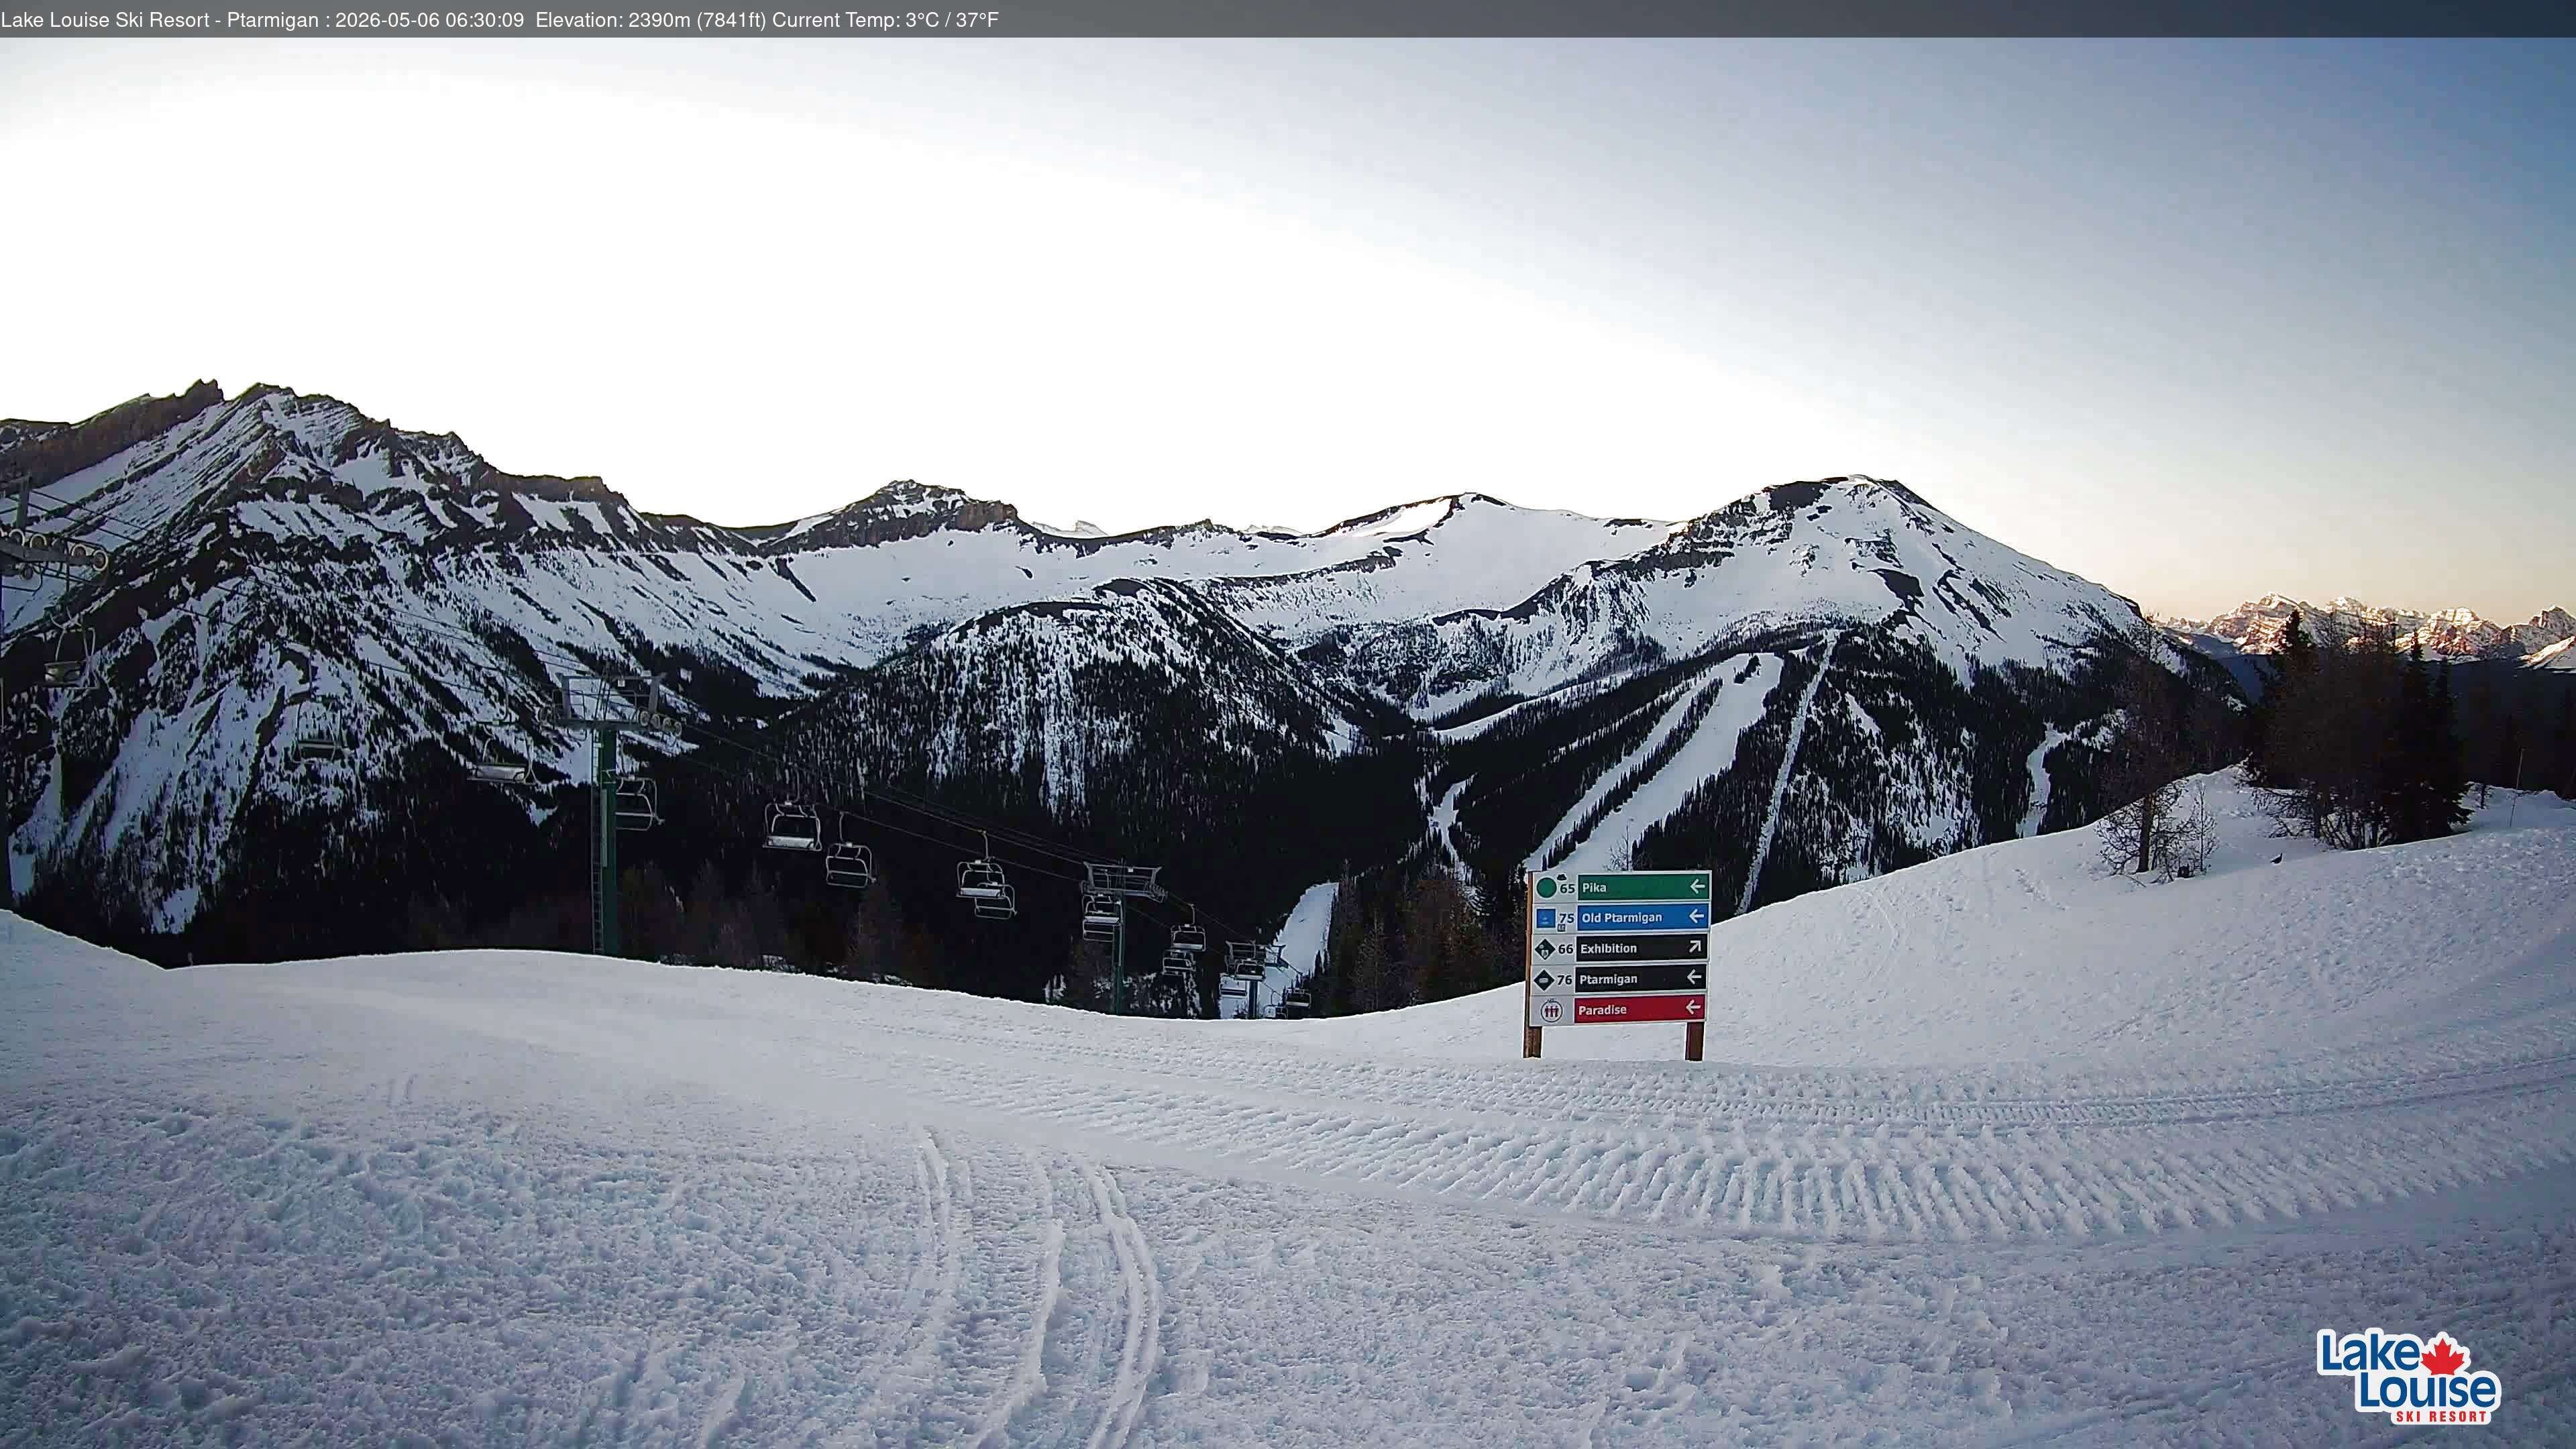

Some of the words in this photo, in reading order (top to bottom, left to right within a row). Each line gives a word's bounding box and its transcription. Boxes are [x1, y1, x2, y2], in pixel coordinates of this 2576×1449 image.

[1560, 883, 1575, 894] 65
[1582, 882, 1607, 893] Pika
[1559, 912, 1574, 924] 75
[1582, 912, 1601, 923] Old
[1604, 912, 1662, 924] Ptarmigan
[1558, 944, 1574, 954] 66
[1580, 943, 1637, 954] Exhibition
[1557, 975, 1572, 985] 76
[1580, 974, 1638, 986] Ptarmigan
[1578, 1005, 1627, 1016] Paradise
